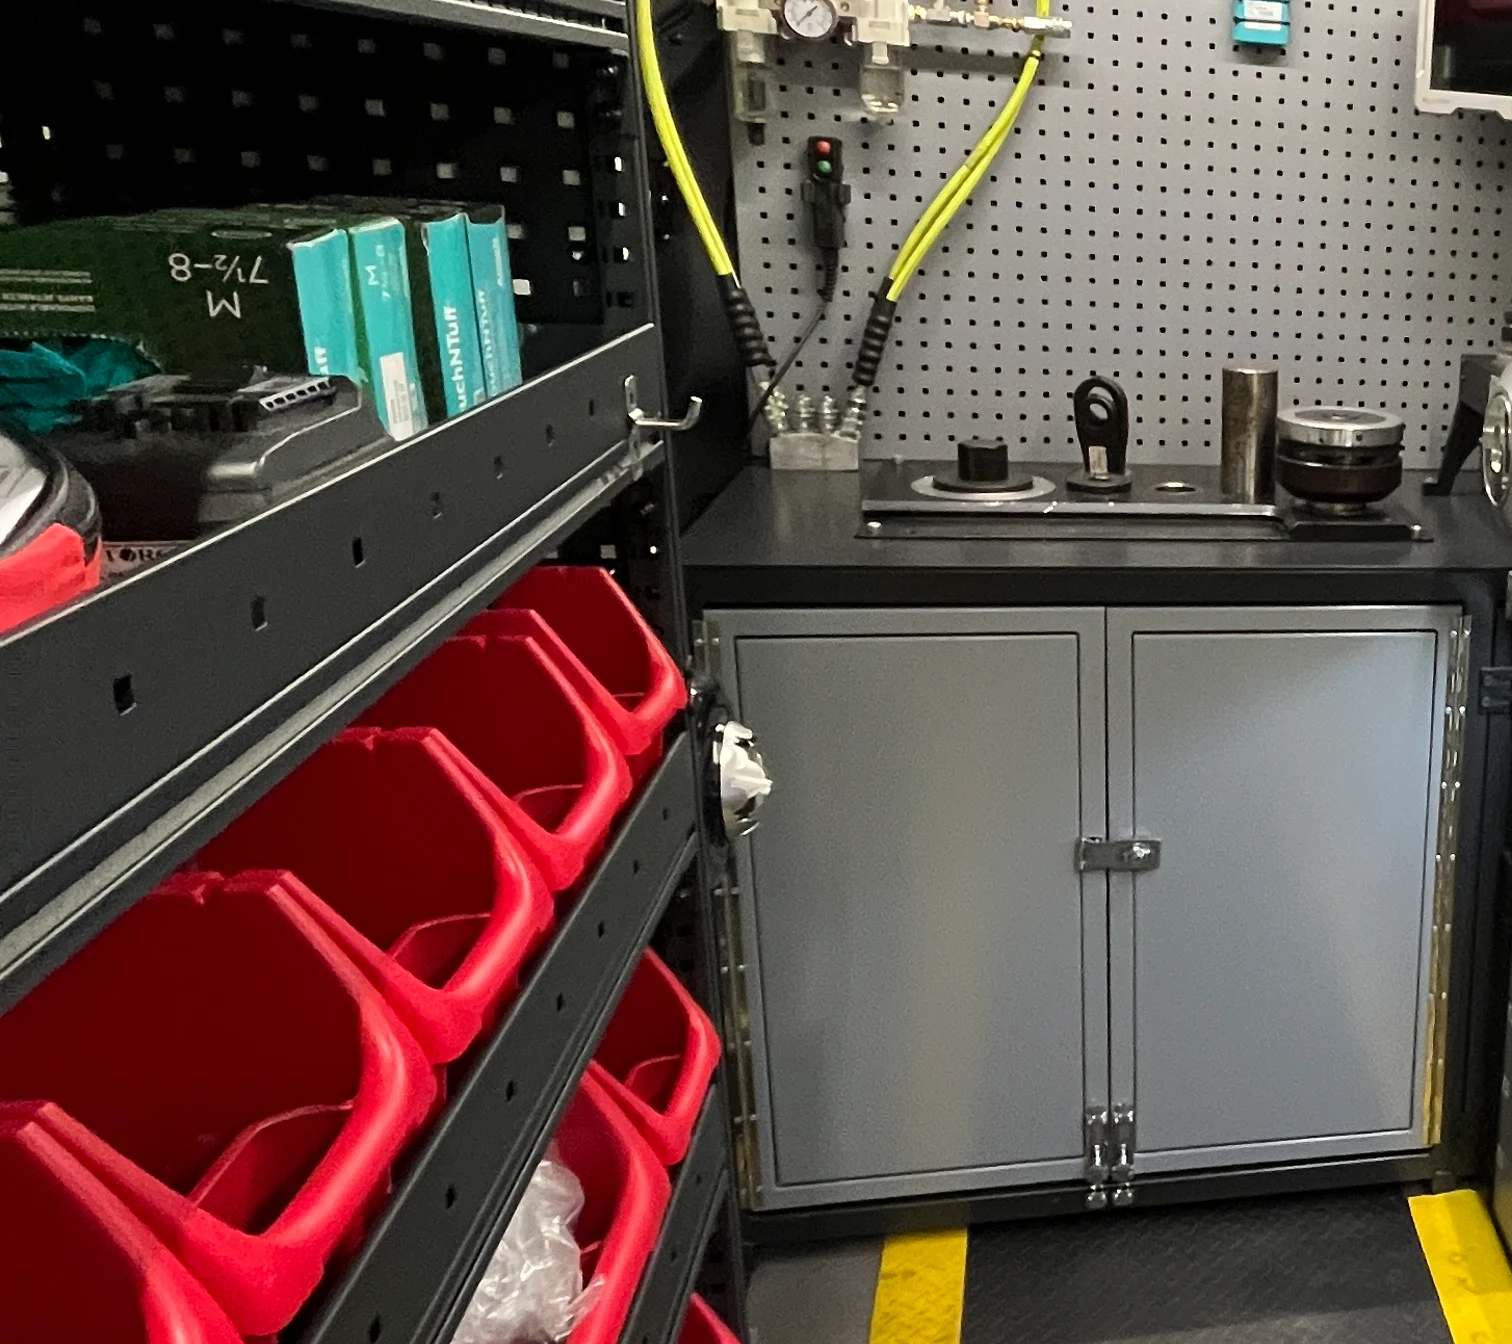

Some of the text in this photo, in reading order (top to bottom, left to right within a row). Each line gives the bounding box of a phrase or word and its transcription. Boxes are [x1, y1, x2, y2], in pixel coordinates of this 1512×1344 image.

[364, 264, 380, 287] M
[205, 290, 242, 320] M
[442, 305, 468, 412] uchNTuff
